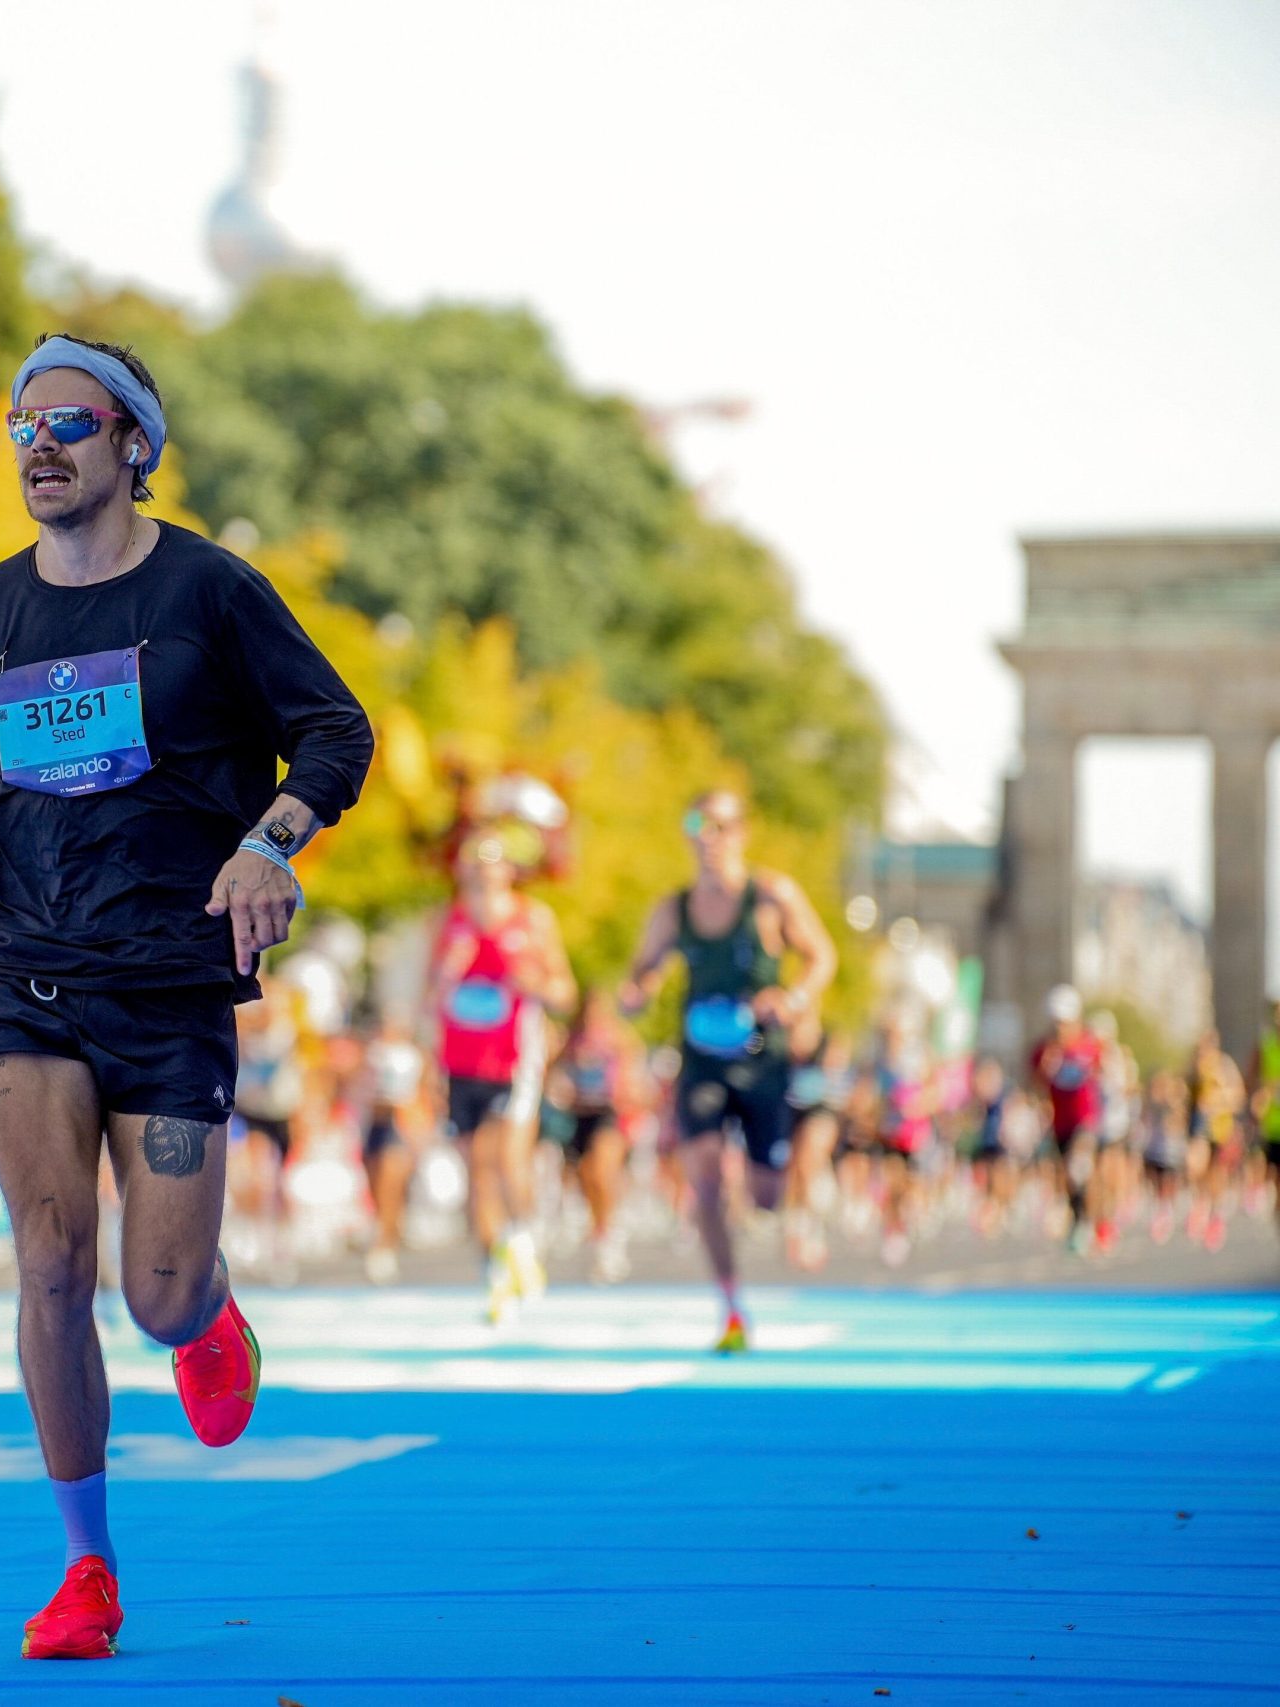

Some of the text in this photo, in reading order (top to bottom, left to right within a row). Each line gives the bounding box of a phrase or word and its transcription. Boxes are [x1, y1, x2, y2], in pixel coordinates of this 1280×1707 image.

[124, 688, 132, 699] C
[23, 691, 106, 730] 31261
[52, 725, 86, 743] Sted
[39, 757, 111, 783] zalando
